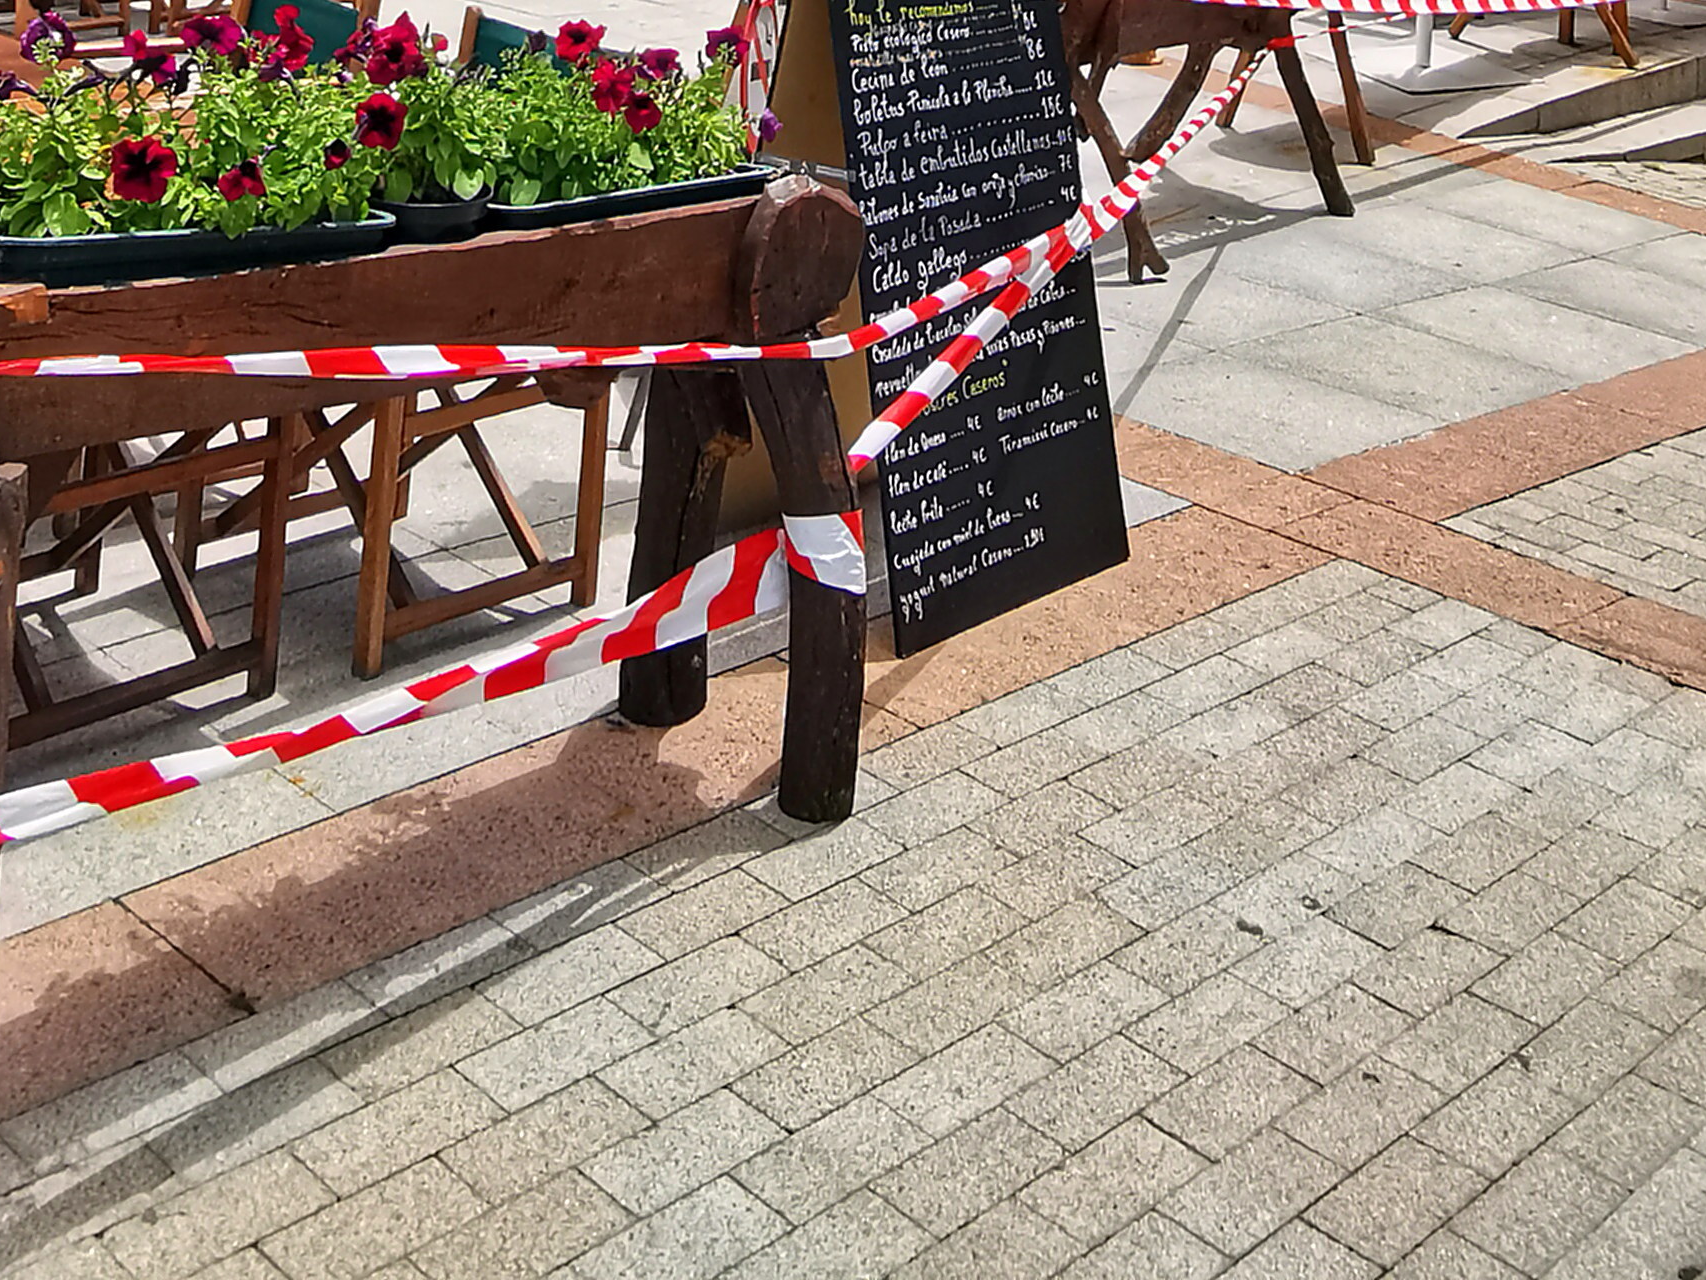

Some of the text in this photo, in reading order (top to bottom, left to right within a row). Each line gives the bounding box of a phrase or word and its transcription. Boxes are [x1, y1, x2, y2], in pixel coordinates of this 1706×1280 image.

[851, 68, 895, 93] Cecina
[900, 62, 915, 86] de
[857, 93, 1064, 160] Pulpo a feira 15€
[901, 157, 916, 182] de
[901, 191, 914, 215] de
[868, 233, 897, 263] Sopa
[902, 226, 918, 252] de
[938, 209, 982, 237] Posada
[872, 259, 910, 293] Caldo
[922, 391, 960, 416] ostres
